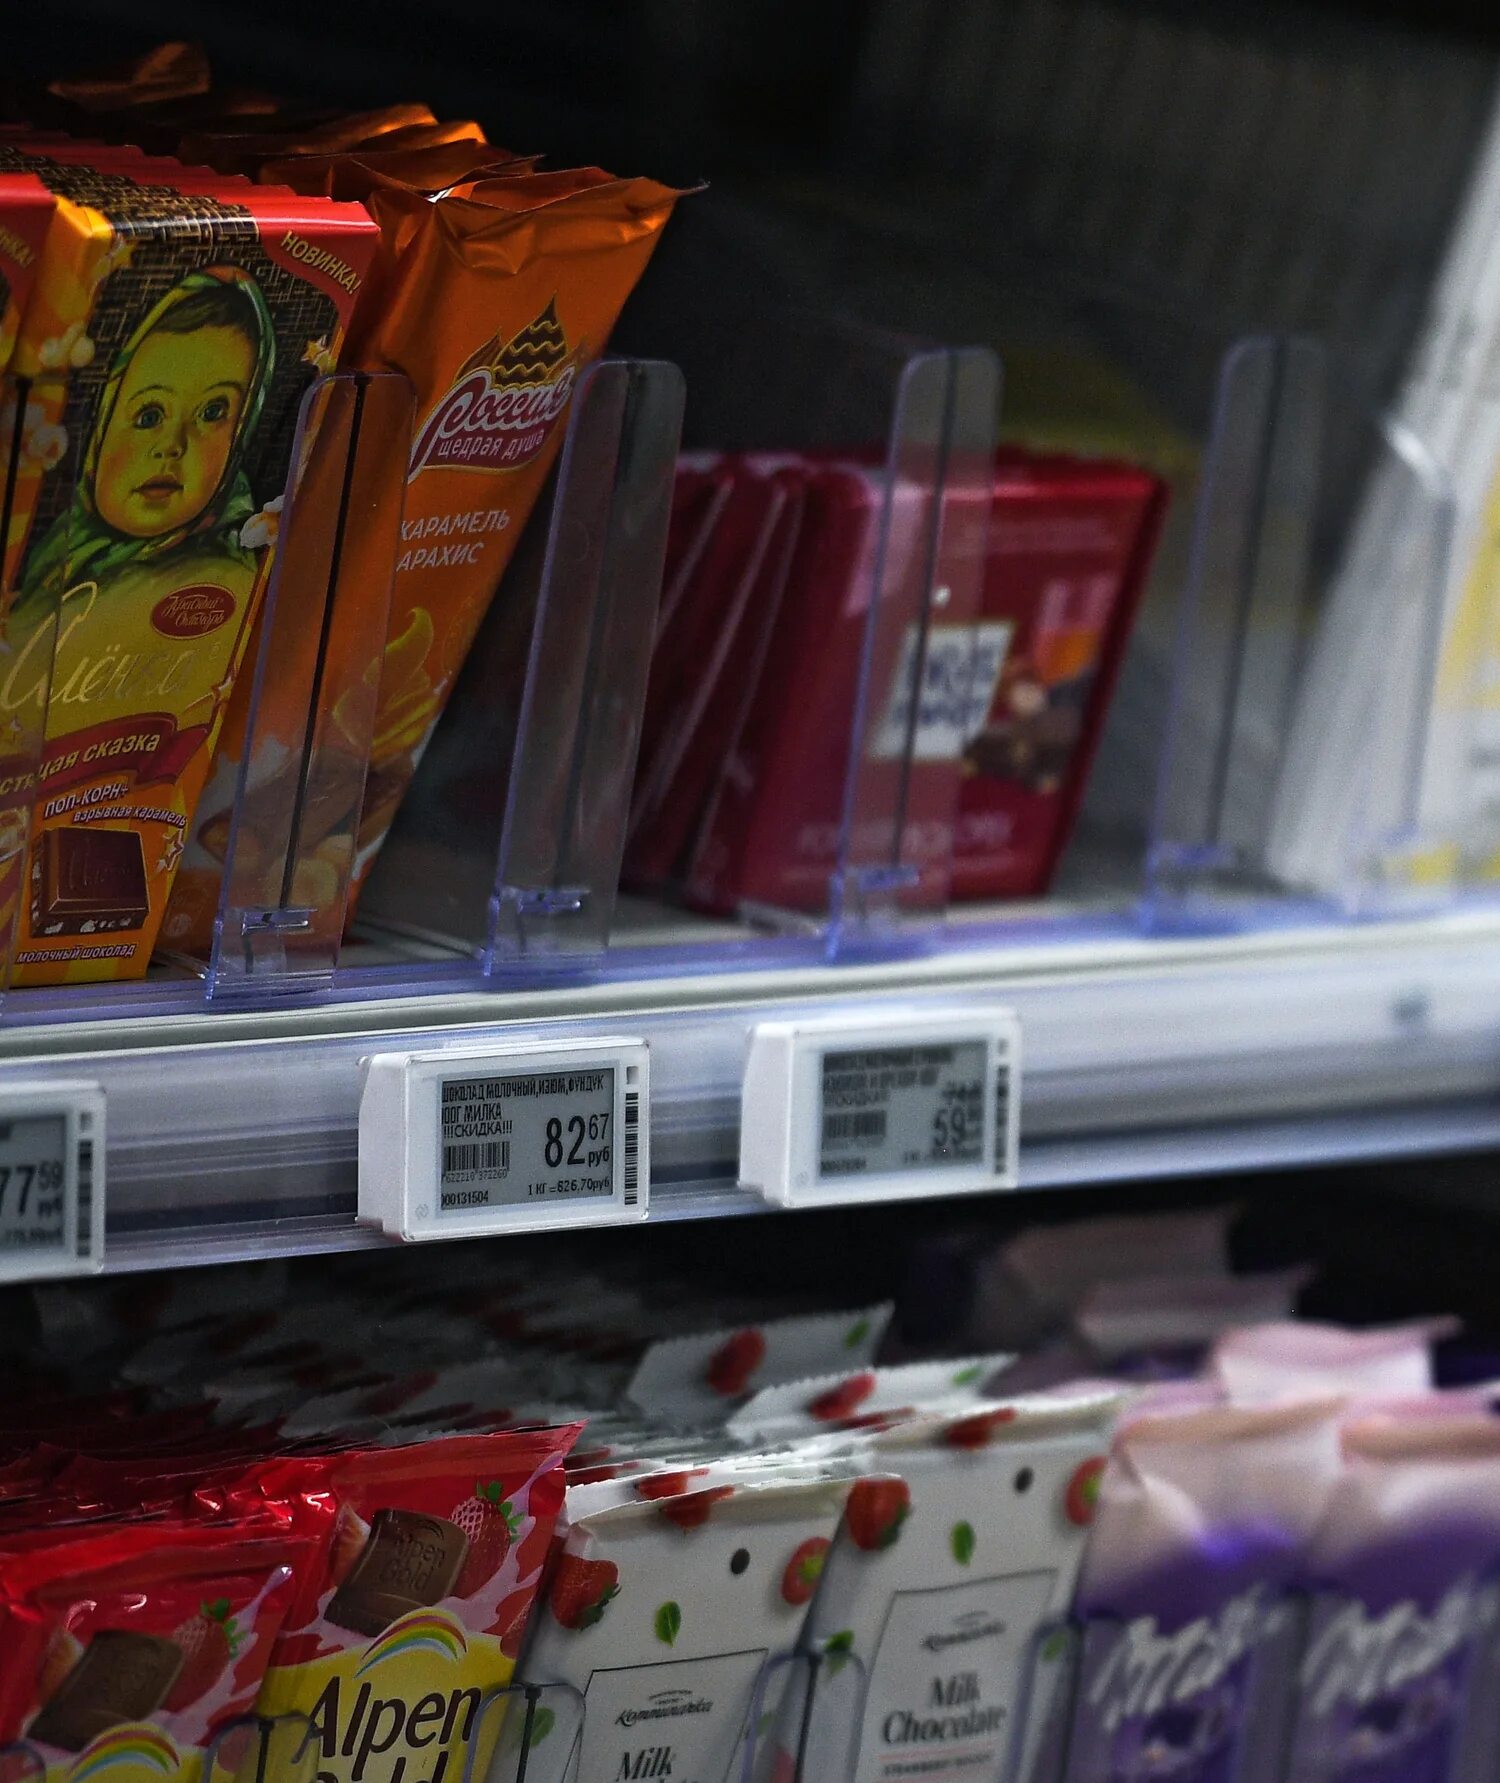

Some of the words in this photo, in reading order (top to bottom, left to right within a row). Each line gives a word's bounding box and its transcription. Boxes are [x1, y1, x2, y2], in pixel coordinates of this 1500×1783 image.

[280, 229, 362, 295] НОВИНКА!
[407, 365, 576, 485] Россия
[437, 435, 502, 461] щедрая
[501, 428, 545, 460] душа
[400, 509, 511, 542] КАРАМЕЛЬ
[396, 542, 485, 573] АРАХИС
[82, 733, 161, 763] сказка
[73, 805, 131, 823] взрывная
[133, 806, 188, 828] карамель
[16, 945, 81, 963] молочный
[81, 943, 137, 959] шоколад
[464, 1102, 502, 1122] МИЛКА
[443, 1120, 512, 1138] !!!СКИДКА!!!
[544, 1115, 586, 1168] 82
[588, 1113, 610, 1140] 67
[588, 1146, 610, 1168] руб
[930, 1672, 981, 1708] Milk
[290, 1675, 482, 1782] Alpen
[615, 1746, 677, 1782] Milk
